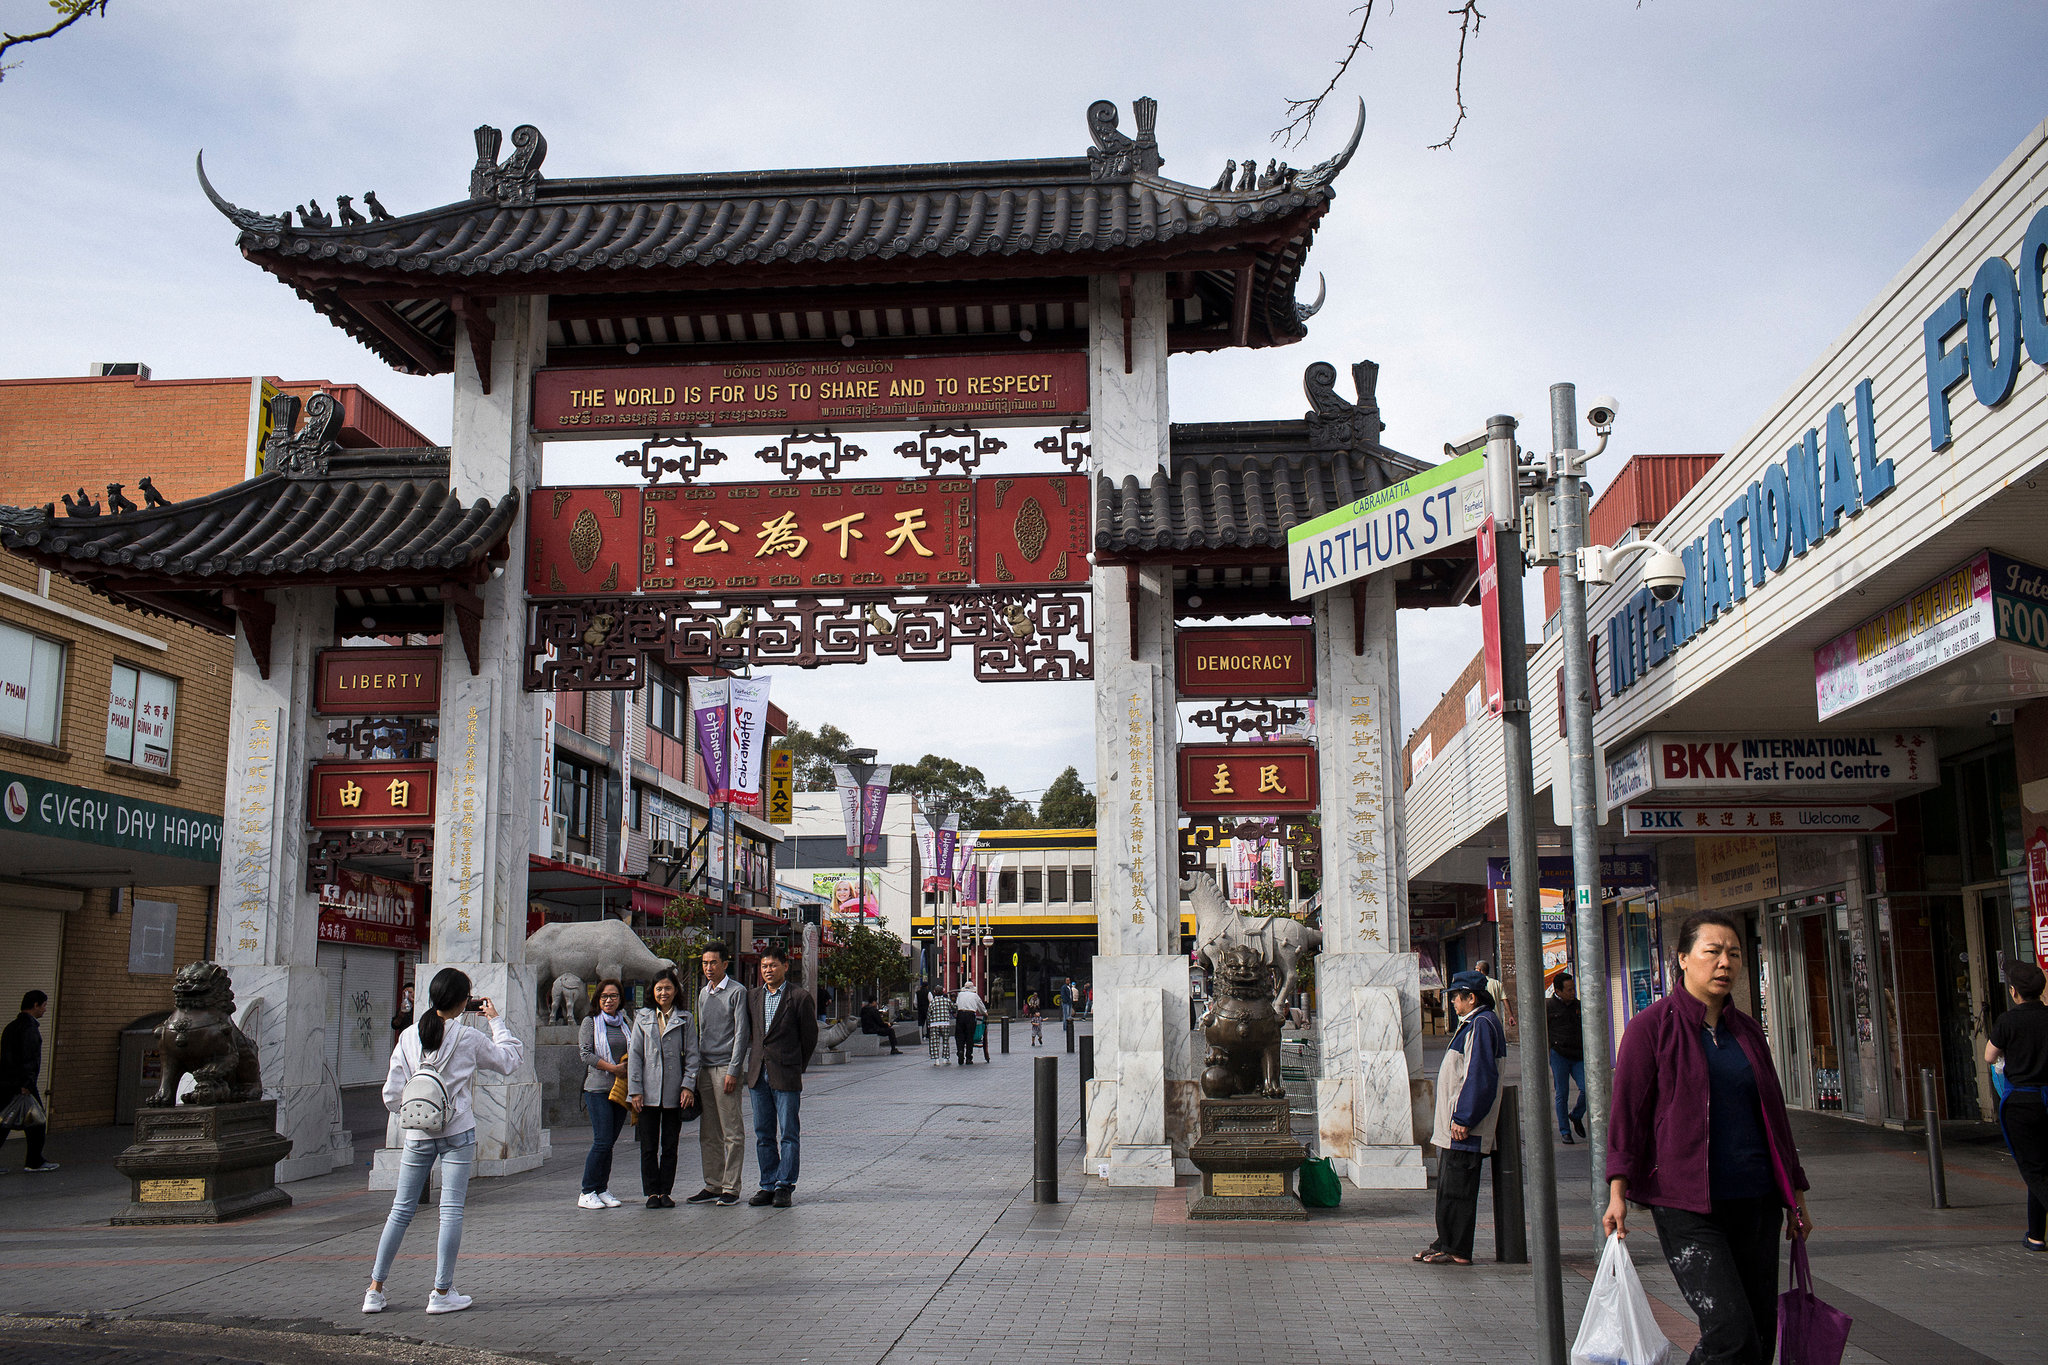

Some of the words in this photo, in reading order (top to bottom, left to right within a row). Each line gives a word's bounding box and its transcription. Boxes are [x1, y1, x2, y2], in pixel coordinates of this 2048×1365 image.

[570, 389, 605, 408] THE
[614, 387, 675, 406] WORLD
[684, 386, 701, 404] IS
[709, 385, 745, 403] FOR
[754, 384, 778, 402] US
[788, 382, 811, 400] TO
[820, 380, 880, 398] SHARE
[889, 379, 925, 397] AND
[935, 377, 958, 396] TO
[967, 374, 1053, 395] RESPECT
[1353, 481, 1410, 515] CABRAMATTA
[1465, 499, 1483, 513] Fairfield
[1302, 508, 1415, 589] ARTHUR
[1422, 486, 1457, 545] ST
[1972, 568, 1989, 593] Inside
[1856, 615, 1888, 666] HOANG
[1889, 602, 1910, 650] ANH
[1910, 565, 1974, 639] JEWELLERY
[1935, 624, 1959, 644] Cabramatta
[1197, 655, 1292, 671] DEMOCRACY
[5, 682, 27, 700] PHAM
[339, 673, 423, 689] LIBERTY
[738, 711, 755, 788] Cabramatta
[1662, 742, 1741, 780] BKK
[1742, 737, 1882, 759] INTERNATIONAL
[542, 707, 553, 827] PLAZA
[1743, 761, 1780, 781] Fast
[1784, 759, 1826, 780] Food
[1838, 760, 1890, 779] Centre
[771, 777, 789, 813] TAX
[40, 792, 108, 832] EVERY
[117, 806, 156, 840] DAY
[163, 815, 223, 852] HAPPY
[1640, 810, 1684, 828] BKK
[1799, 811, 1860, 825] Welcome
[939, 832, 952, 876] Cabramatta
[344, 889, 414, 927] CHEMIST
[1579, 889, 1589, 904] H
